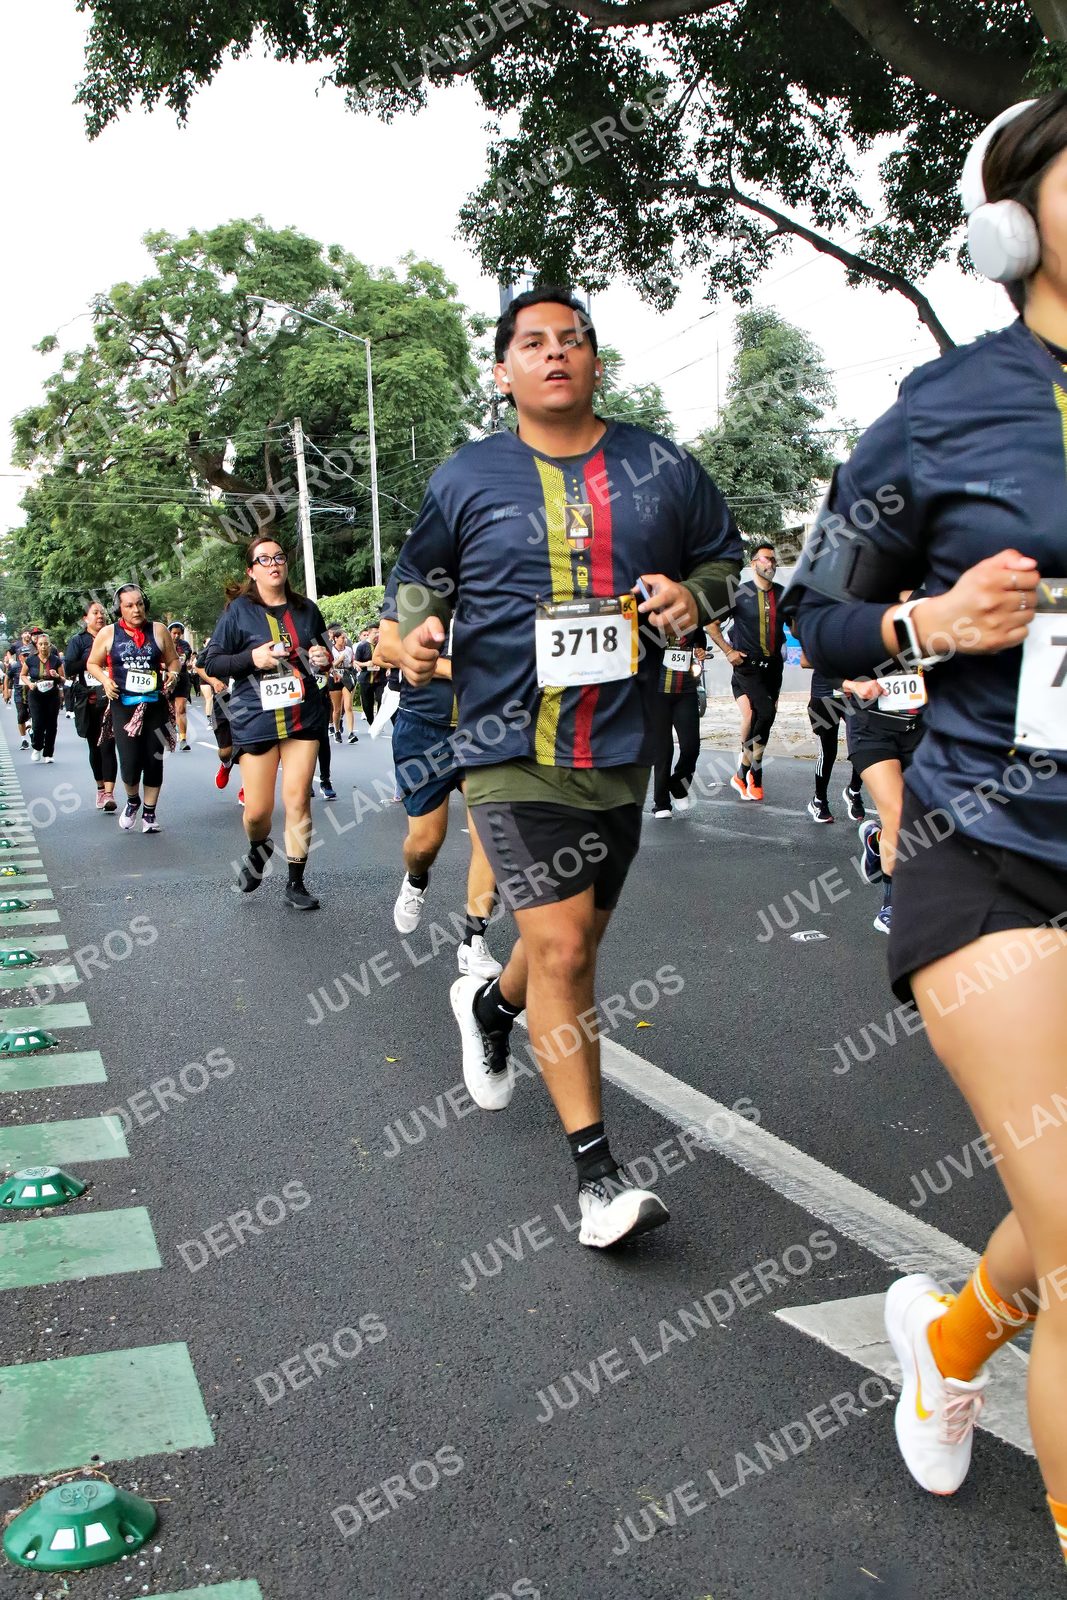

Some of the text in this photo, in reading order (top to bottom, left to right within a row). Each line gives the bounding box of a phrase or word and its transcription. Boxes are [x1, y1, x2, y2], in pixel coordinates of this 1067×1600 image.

[551, 626, 618, 657] 3718
[671, 653, 686, 663] 854
[131, 675, 151, 686] 1136
[885, 680, 917, 696] 3610
[265, 681, 295, 697] 8254
